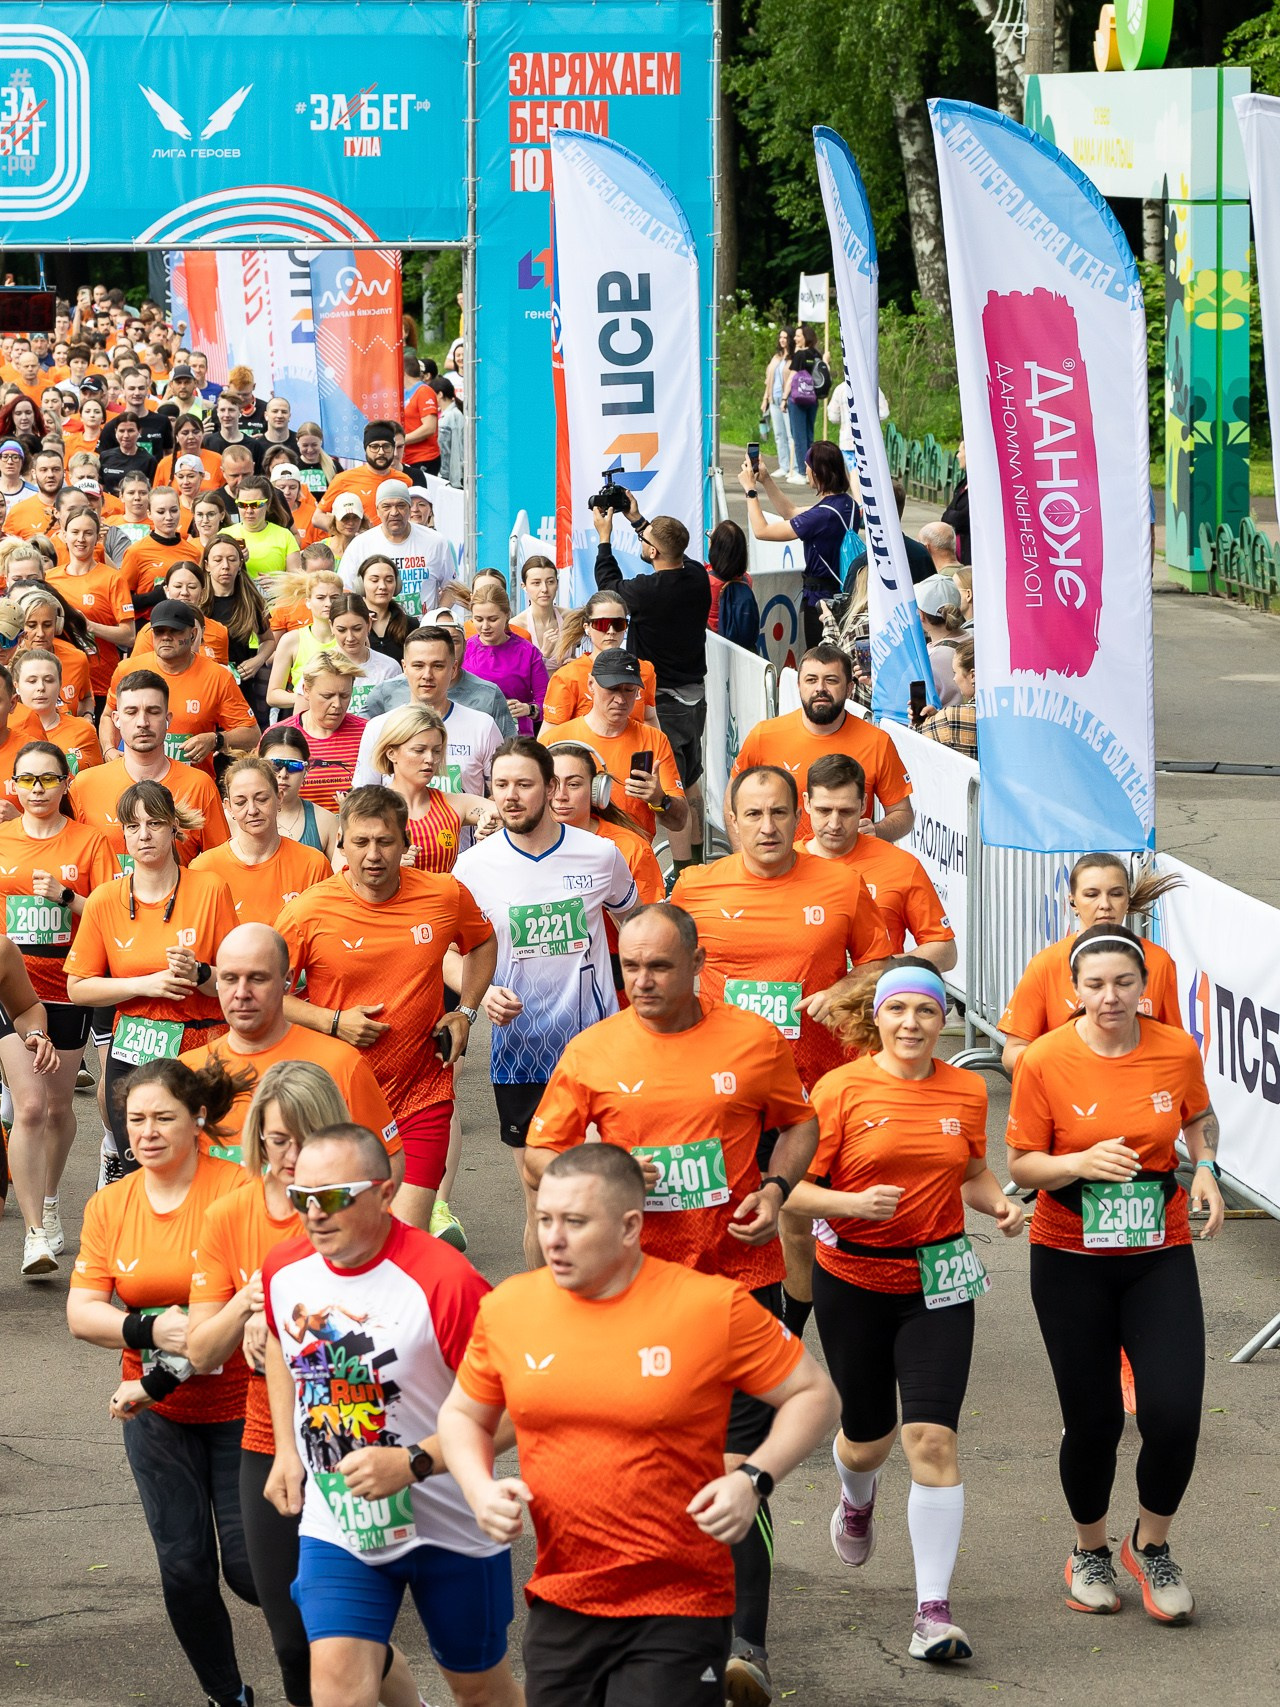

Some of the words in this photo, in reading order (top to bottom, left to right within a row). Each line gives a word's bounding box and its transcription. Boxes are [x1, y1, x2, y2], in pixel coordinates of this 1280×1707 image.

[509, 53, 680, 95] ЗАРЯЖАЕМ
[509, 101, 608, 143] БЕГОМ
[152, 149, 186, 158] ЛИГА
[191, 149, 241, 158] ГЕРОЕВ
[344, 136, 381, 156] ТУЛА
[510, 149, 544, 192] 10
[60, 864, 78, 881] 10
[17, 906, 62, 931] 2000
[525, 912, 573, 945] 2221
[802, 905, 825, 925] 10
[176, 928, 196, 947] 10
[410, 923, 433, 946] 10
[122, 1022, 169, 1058] 2303
[1214, 983, 1280, 1105] ПСБ
[711, 1071, 736, 1095] 10
[1151, 1091, 1173, 1114] 10
[654, 1156, 710, 1194] 2401
[1098, 1197, 1155, 1231] 2302
[638, 1345, 671, 1377] 10
[328, 1490, 392, 1530] 2130
